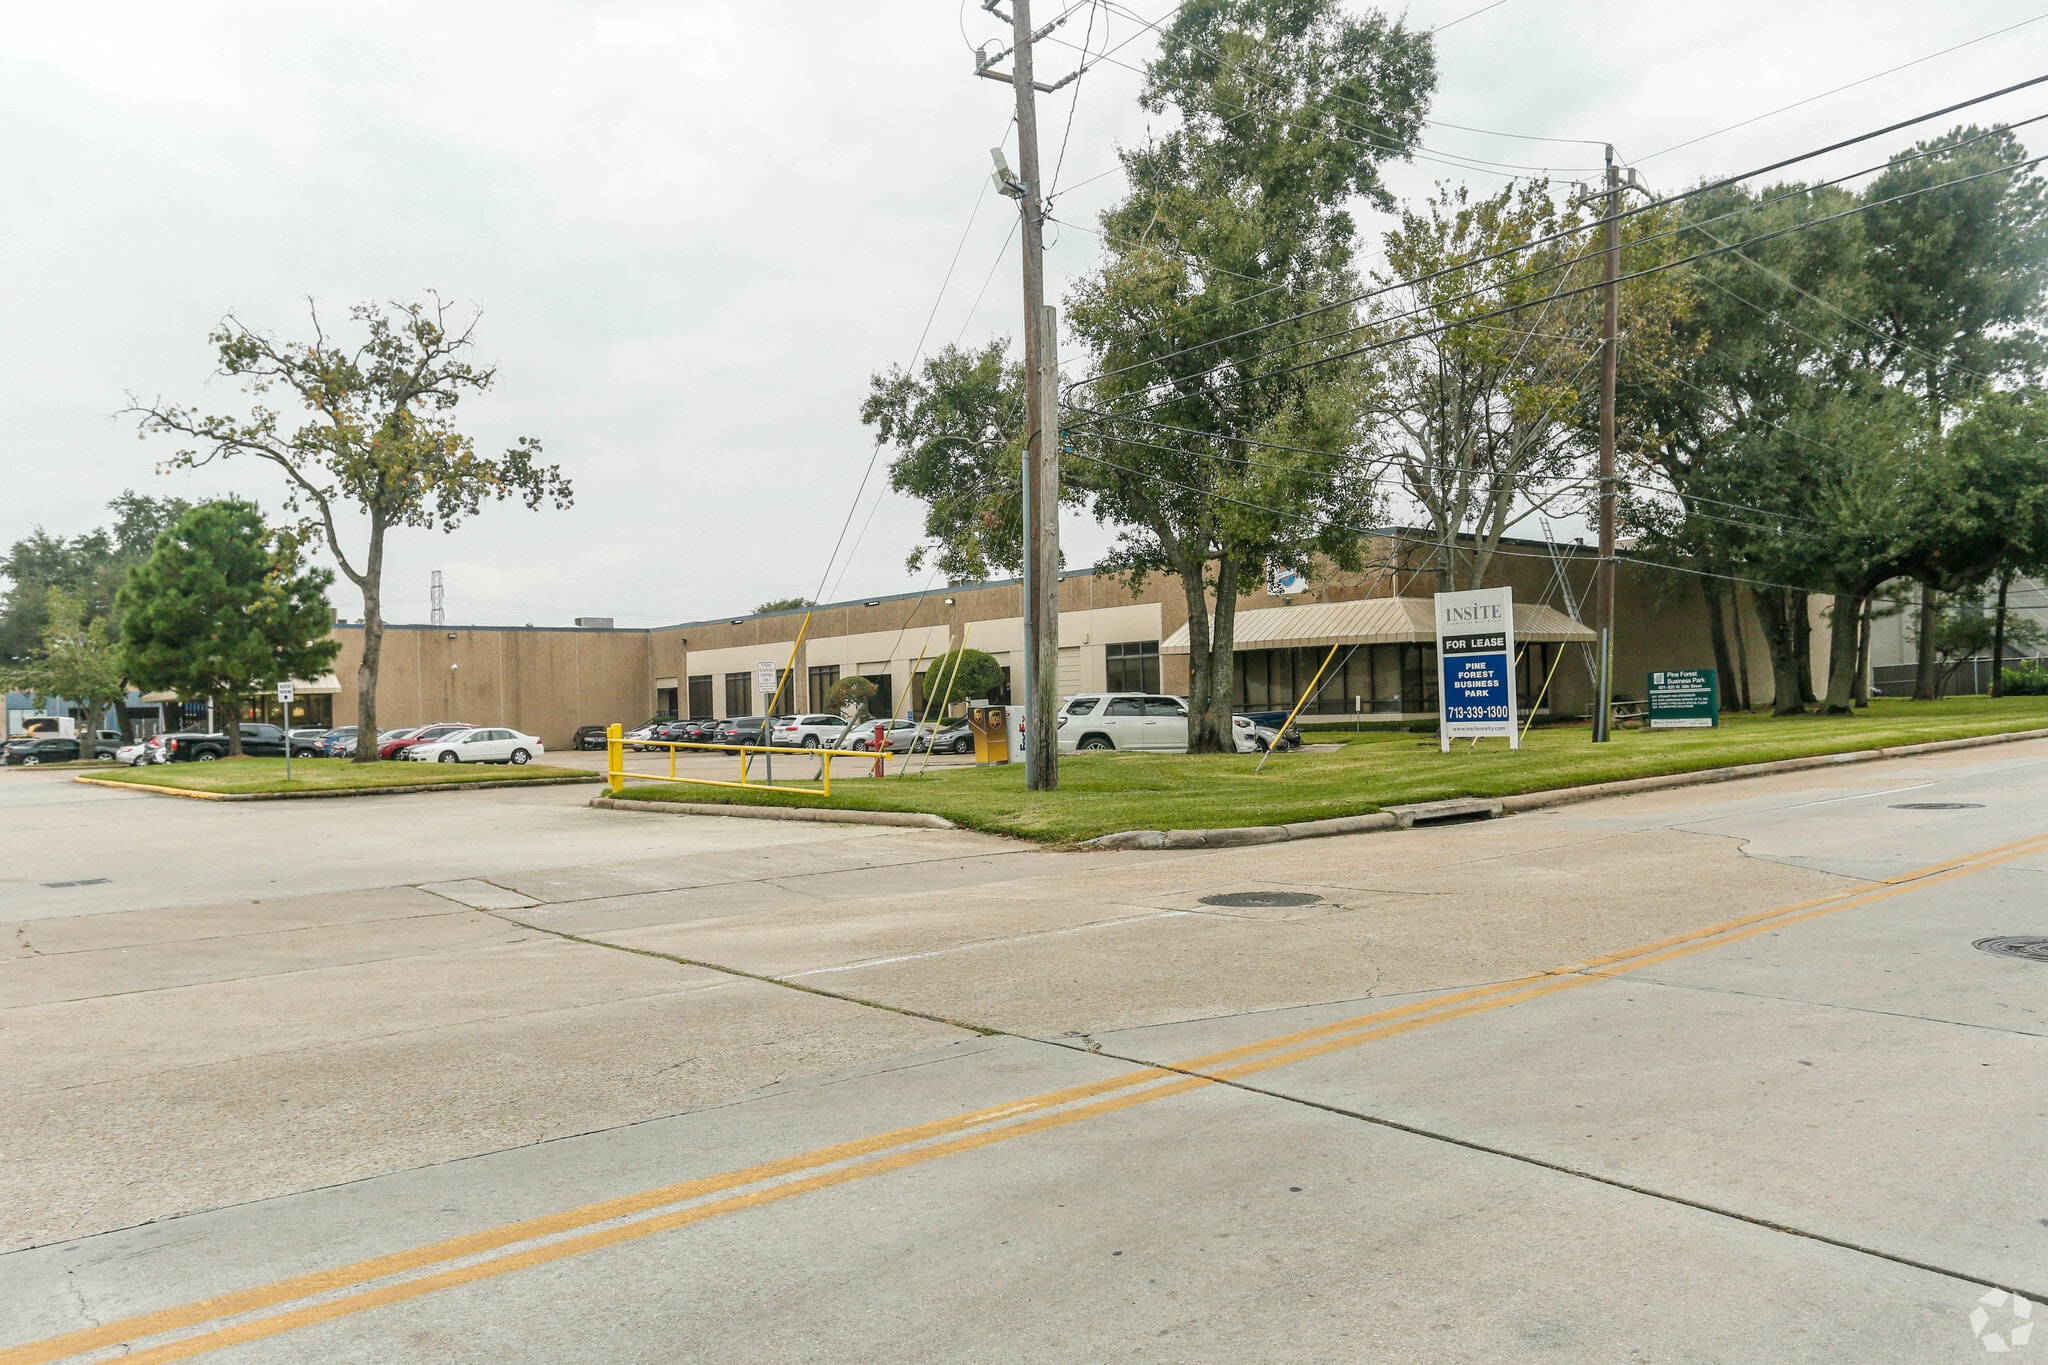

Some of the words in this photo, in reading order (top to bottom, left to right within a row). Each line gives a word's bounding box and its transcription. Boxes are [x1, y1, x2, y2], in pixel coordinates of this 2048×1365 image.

[1446, 640, 1466, 650] FOR
[1471, 637, 1505, 648] LEASE
[1465, 662, 1487, 670] PINE
[1458, 670, 1494, 679] FOREST
[1454, 680, 1500, 688] BUSINESS
[1448, 705, 1508, 719] 713-339-1300
